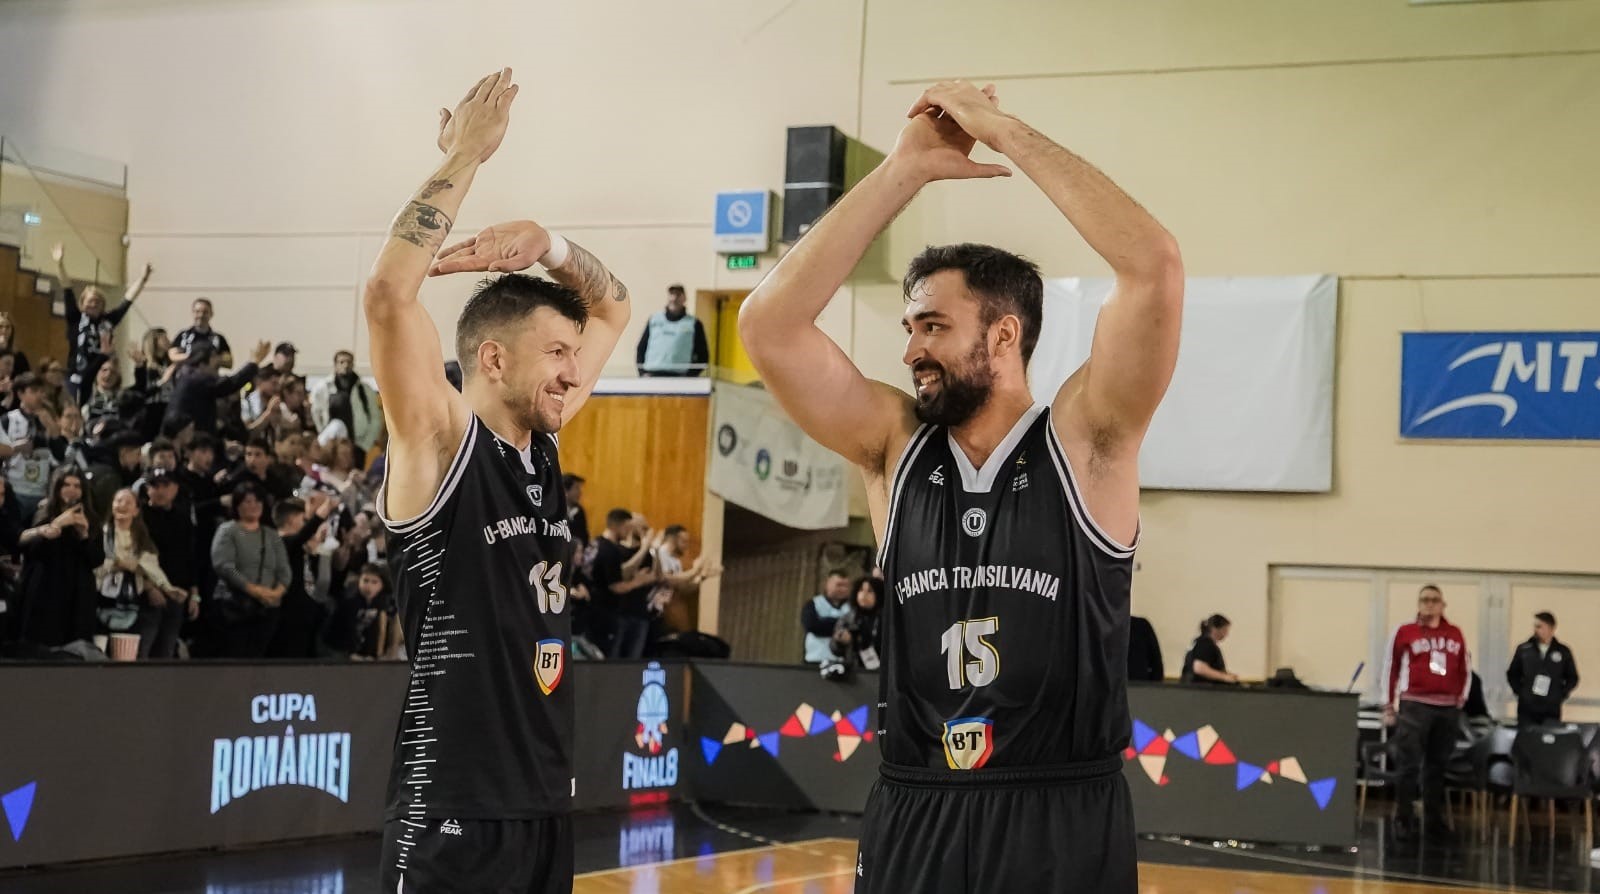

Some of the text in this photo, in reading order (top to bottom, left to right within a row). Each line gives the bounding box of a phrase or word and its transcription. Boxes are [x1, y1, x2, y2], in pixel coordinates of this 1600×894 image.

[1491, 341, 1600, 393] MT
[483, 516, 537, 545] U-BANCA
[528, 560, 566, 614] 13
[895, 567, 949, 605] U-BANCA
[541, 652, 560, 669] BT
[941, 616, 999, 690] 15
[251, 692, 317, 724] CUPA
[952, 731, 982, 751] BT
[210, 724, 351, 815] ROMÂNIEI
[440, 826, 463, 836] PEAK
